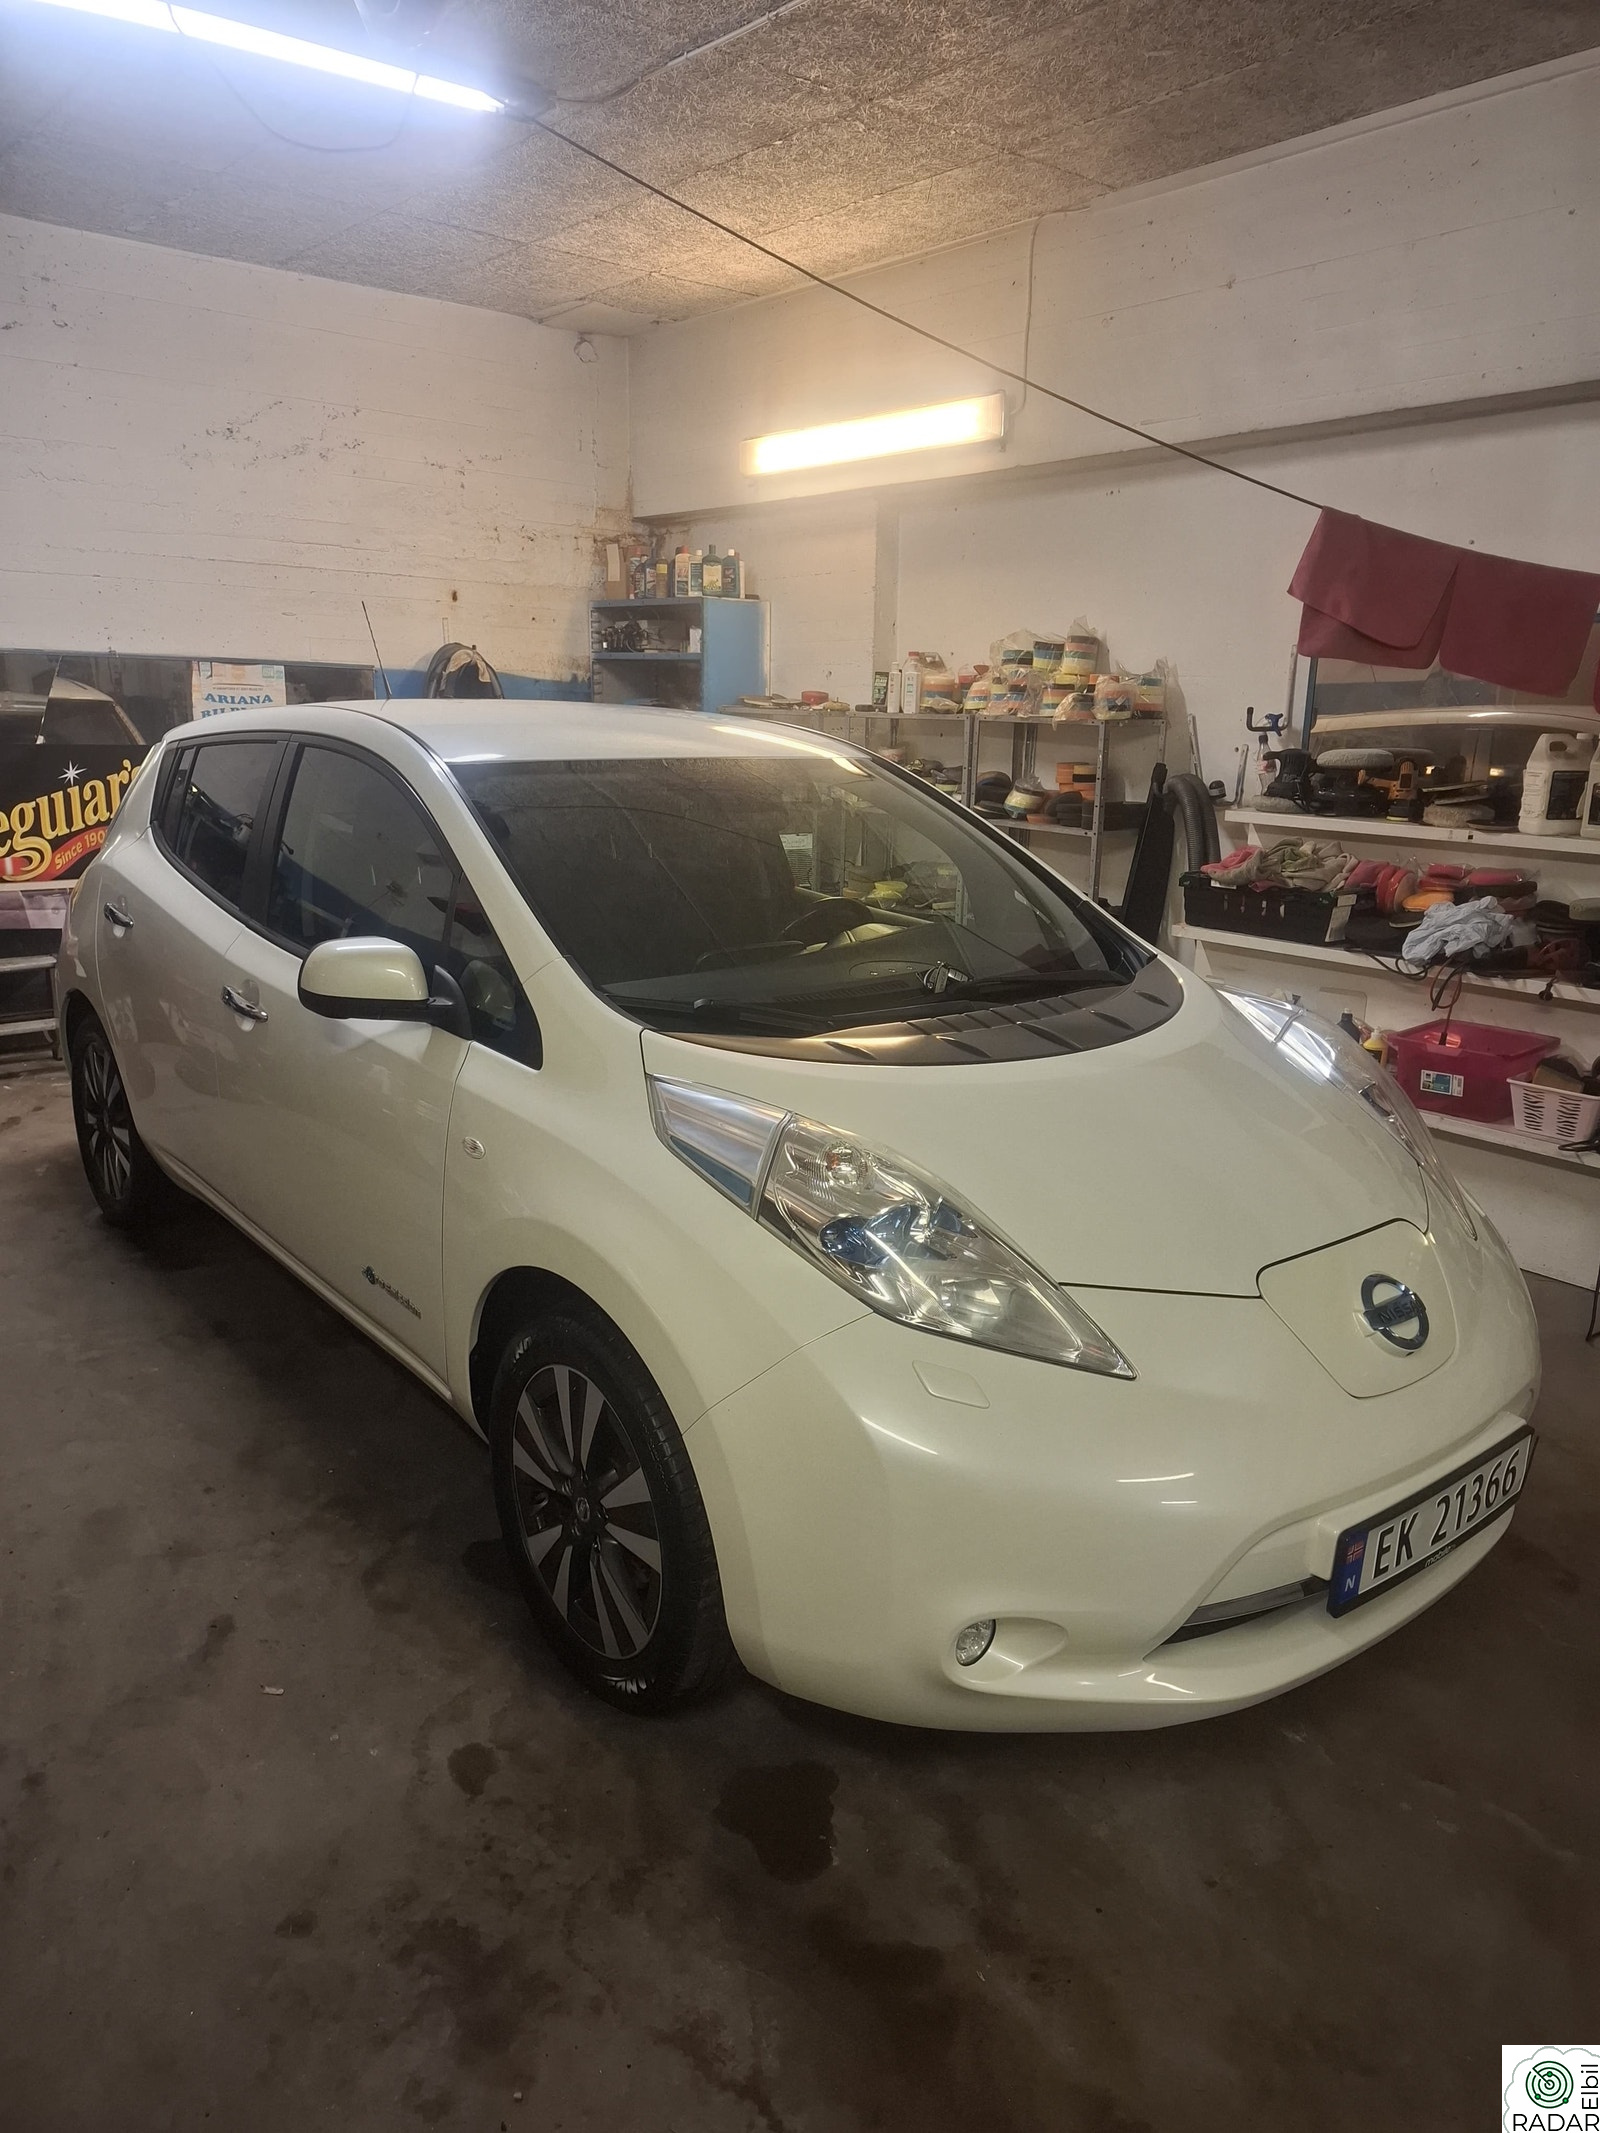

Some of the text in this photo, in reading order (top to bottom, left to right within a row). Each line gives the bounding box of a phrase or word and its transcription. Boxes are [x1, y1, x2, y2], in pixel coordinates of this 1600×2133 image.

[204, 692, 273, 705] ARIANA
[54, 829, 108, 870] Since 190
[1372, 1448, 1520, 1580] EK 21366
[1344, 1574, 1356, 1592] N
